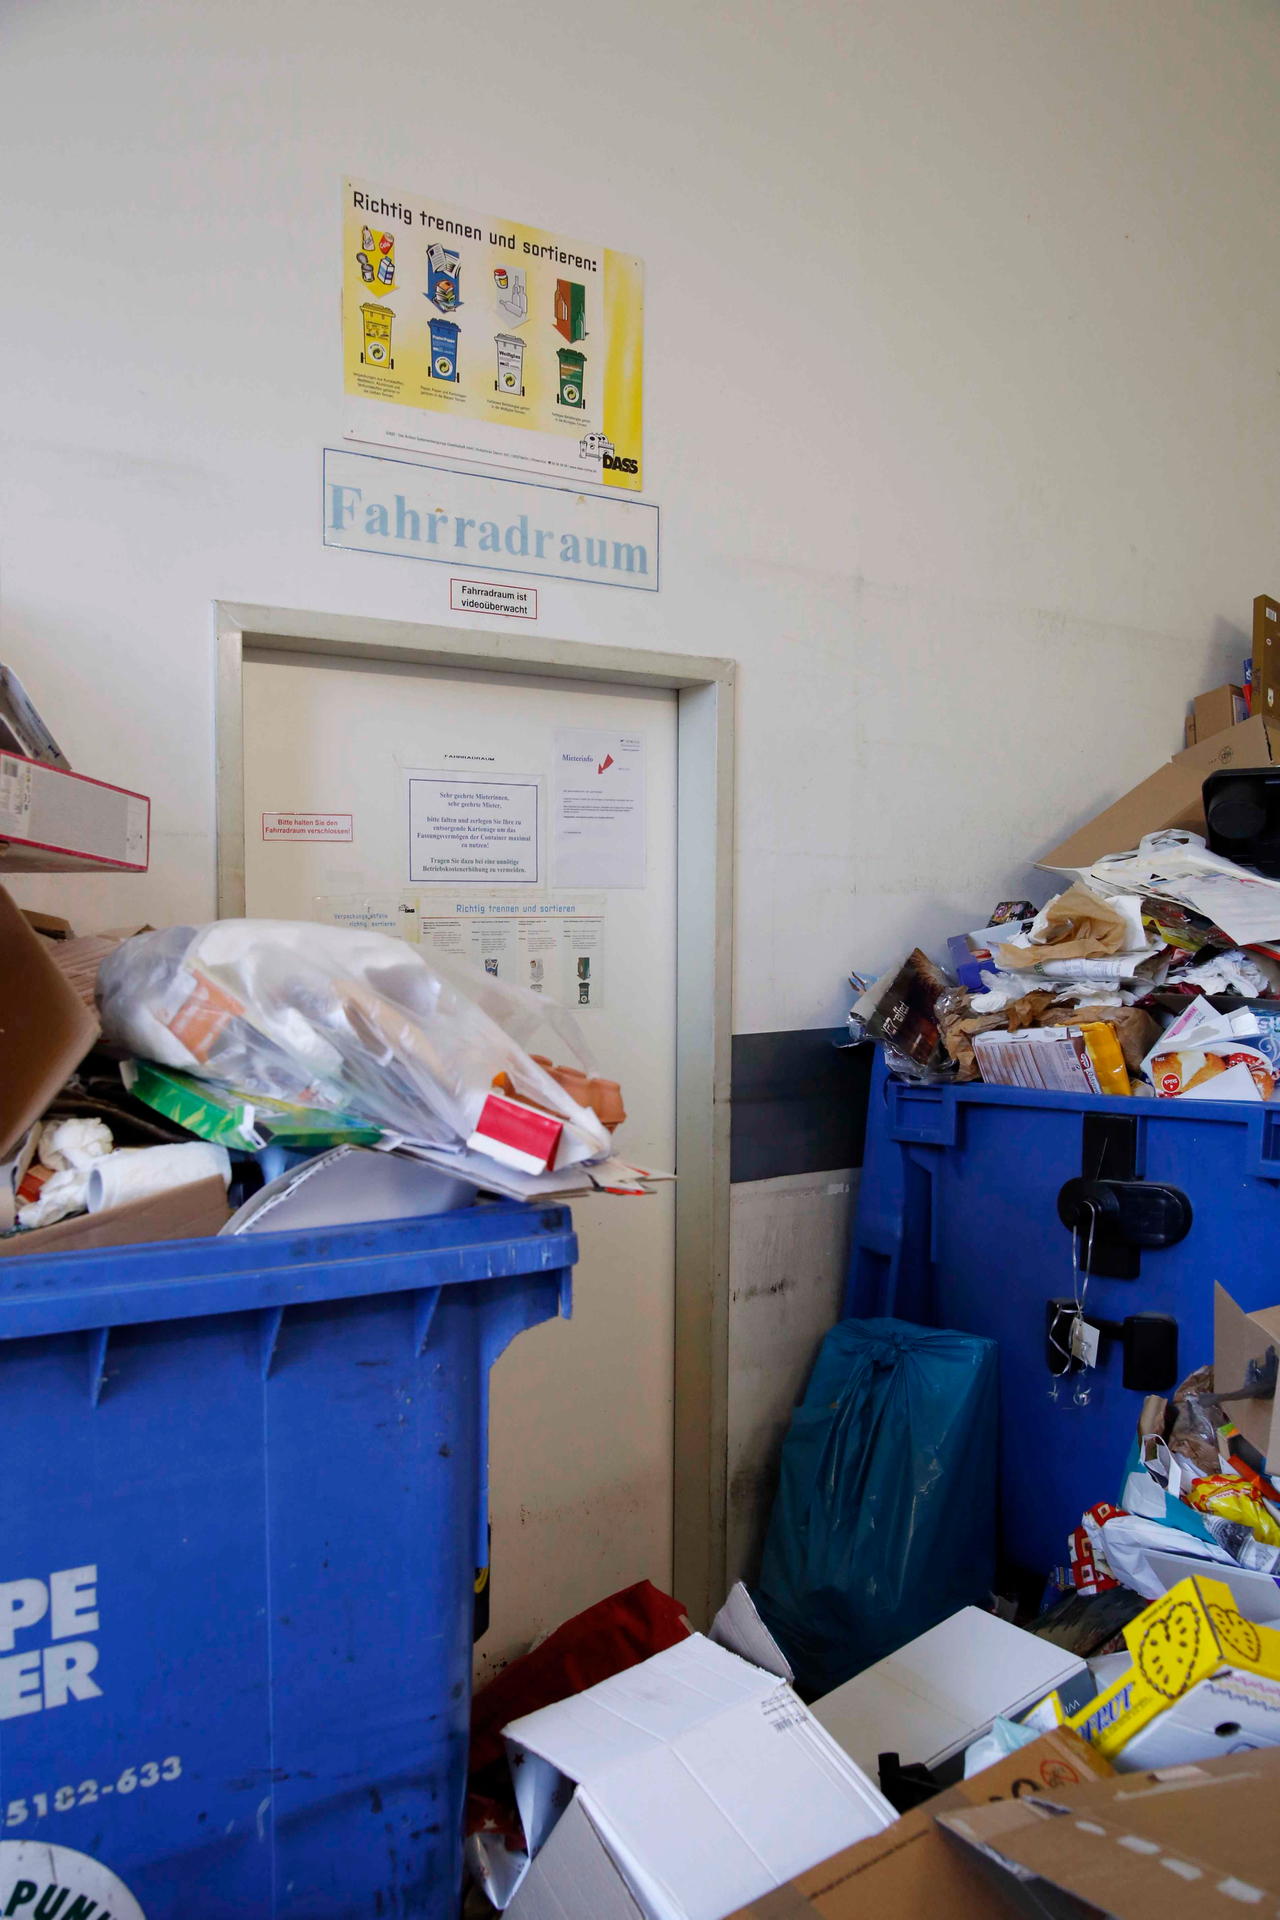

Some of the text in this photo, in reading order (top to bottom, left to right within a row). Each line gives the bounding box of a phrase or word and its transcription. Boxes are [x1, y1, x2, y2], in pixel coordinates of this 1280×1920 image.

[353, 191, 597, 272] Richtig trennen und sortieren:
[602, 454, 639, 474] DASS
[328, 483, 649, 576] Fahrradraum
[461, 585, 527, 602] Fahrradraum ist
[461, 598, 528, 615] videoüberwacht
[456, 903, 576, 914] Richtig trennen und sortieren
[0, 1640, 104, 1721] ER
[0, 1756, 183, 1828] 5182-633
[4, 1880, 112, 1920] PUN
